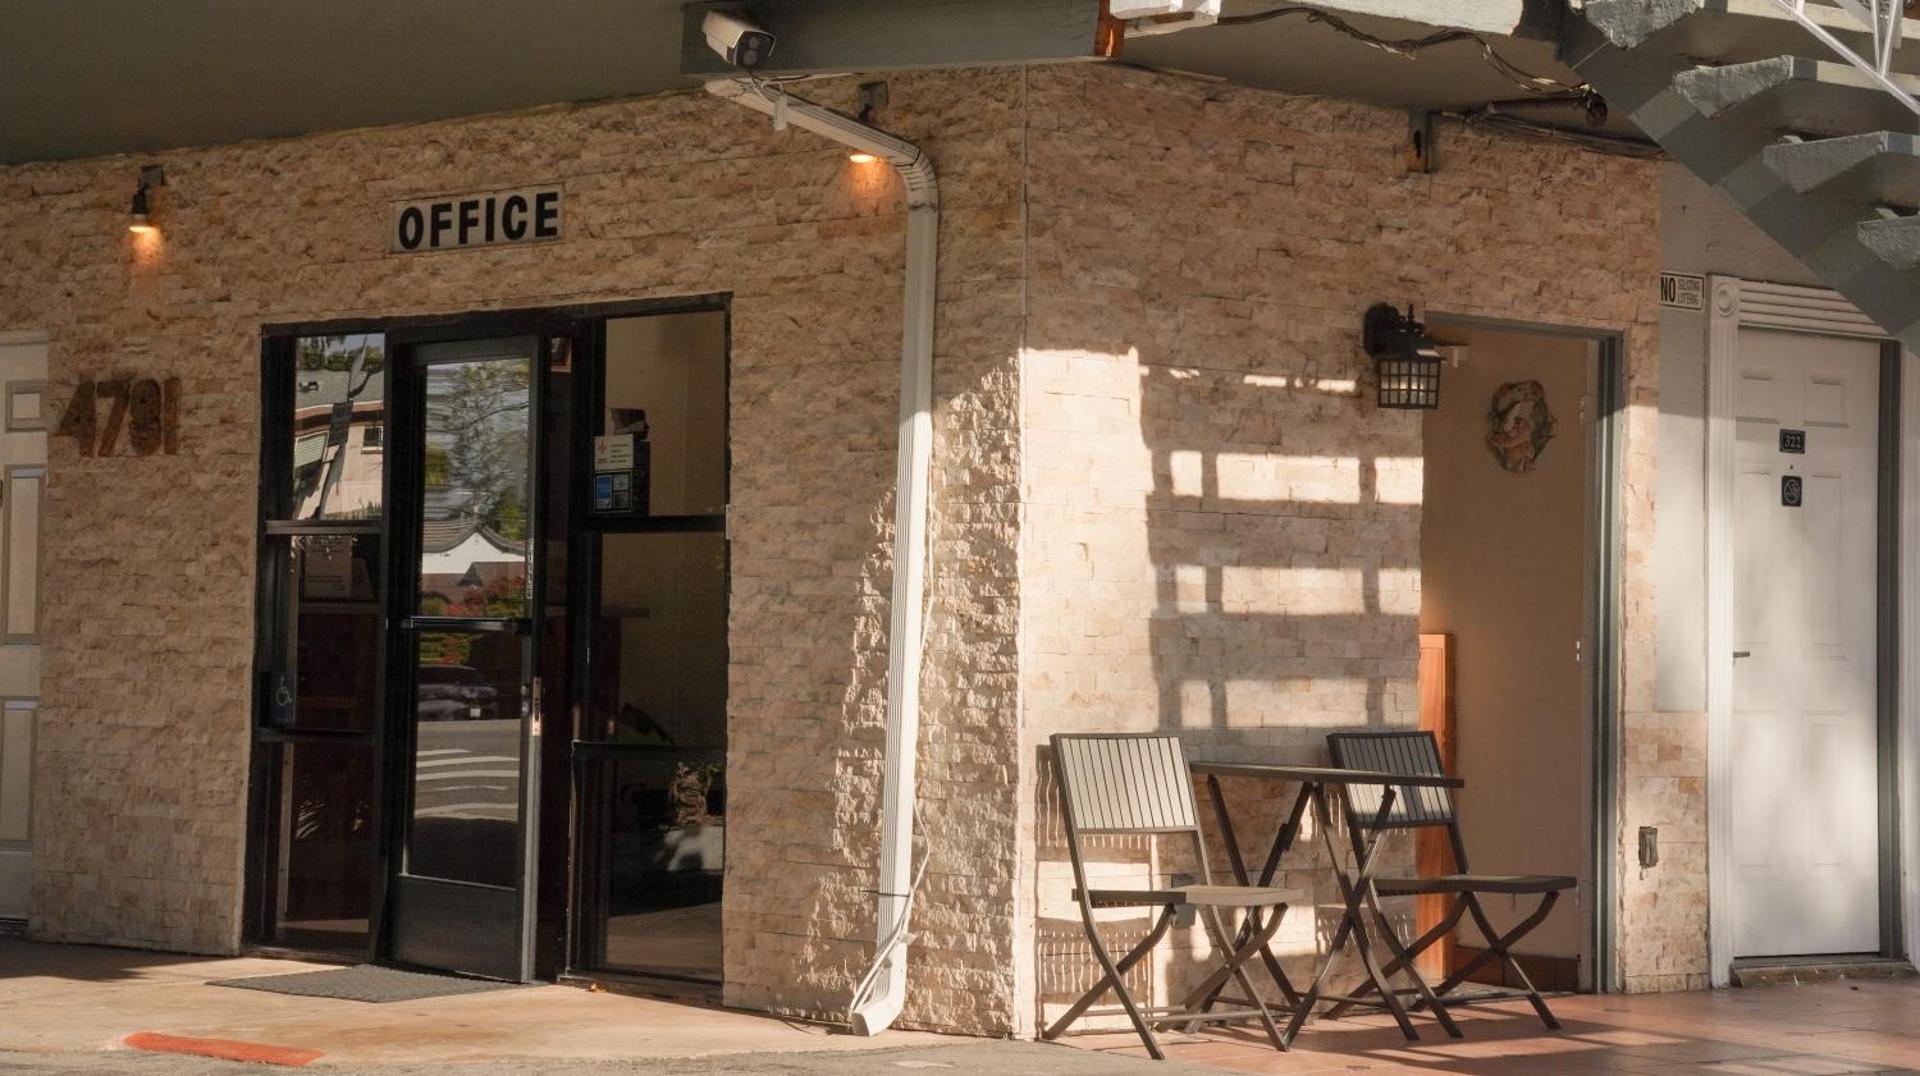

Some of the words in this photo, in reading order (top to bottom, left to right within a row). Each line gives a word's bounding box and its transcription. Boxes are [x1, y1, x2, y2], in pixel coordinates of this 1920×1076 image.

[398, 191, 559, 250] OFFICE
[1660, 276, 1676, 302] NO
[1784, 434, 1802, 449] 322
